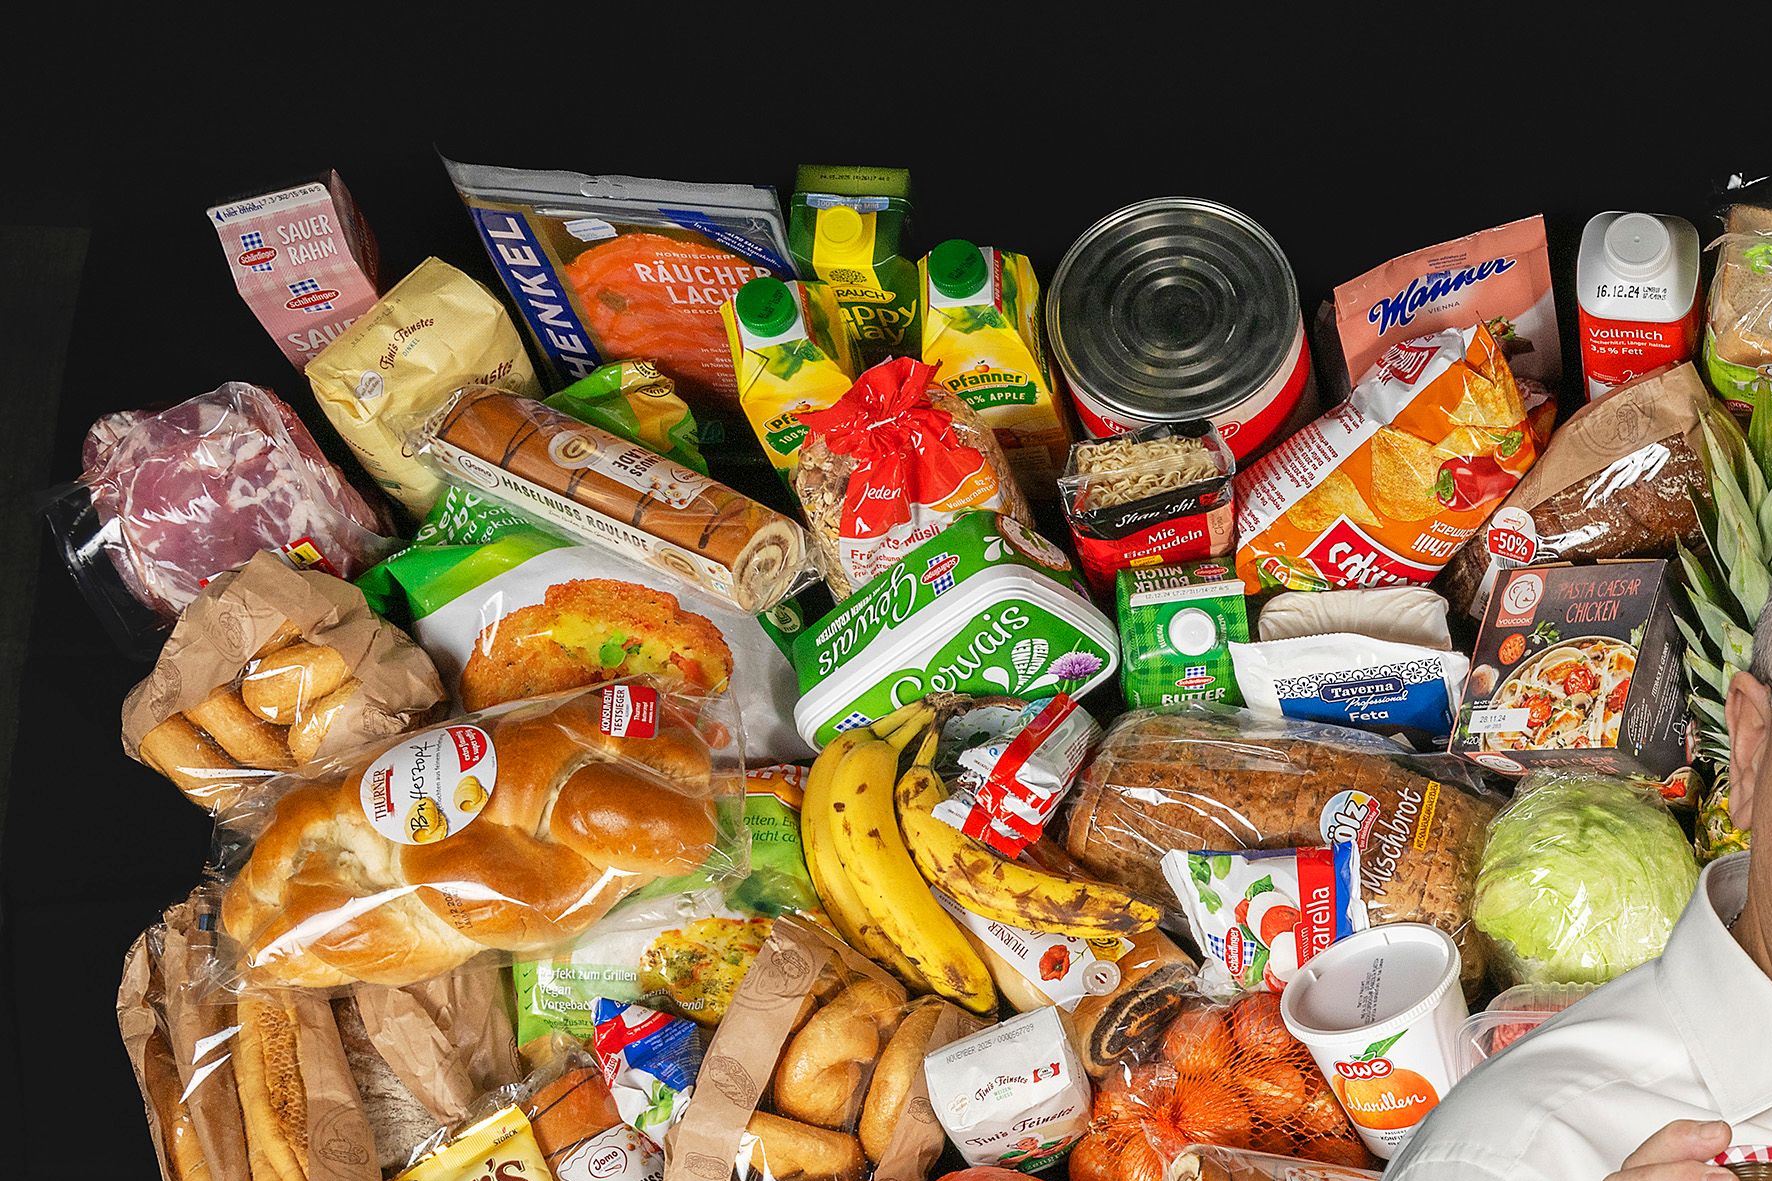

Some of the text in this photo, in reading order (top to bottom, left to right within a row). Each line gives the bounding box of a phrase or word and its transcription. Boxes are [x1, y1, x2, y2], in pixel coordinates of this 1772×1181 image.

[276, 214, 333, 245] SAUER
[241, 250, 275, 264] Schärdinger
[287, 237, 338, 266] RAHM
[289, 291, 336, 308] Schärdinger
[835, 288, 885, 301] RAUCH
[1368, 256, 1517, 336] Manner
[1596, 285, 1640, 299] 16.12.24
[1427, 301, 1460, 315] VIENNA
[1588, 327, 1663, 341] Vollmilch
[402, 337, 421, 357] DINKEL
[1621, 346, 1643, 356] Fett
[951, 373, 1024, 390] Pfanner
[990, 392, 1026, 402] APPLE
[946, 480, 996, 510] Vollkornanteil
[502, 476, 581, 522] HASELNUSS
[586, 516, 649, 552] ROULADE
[1124, 528, 1203, 559] Eiernudeln
[1148, 526, 1176, 544] Mie
[1493, 532, 1528, 556] -50%
[1559, 579, 1641, 599] PASTA CAESAR
[1565, 600, 1618, 623] CHICKEN
[1162, 687, 1225, 706] BUTTER
[1330, 681, 1394, 699] Taverna
[613, 689, 625, 732] TESTSIEGER
[1344, 690, 1408, 711] Professional
[600, 690, 613, 732] KONSUMENT
[1349, 710, 1389, 722] Feta
[375, 768, 386, 822] THURNER
[1361, 787, 1422, 896] Mischbrot
[987, 922, 1028, 960] THURNER
[578, 970, 600, 980] zum
[603, 969, 637, 982] Grillen
[946, 1045, 977, 1064] NOVEMBER
[978, 1040, 992, 1051] 2025
[1346, 1093, 1427, 1112] Marillen
[1012, 1105, 1075, 1133] Feinstes
[493, 1129, 518, 1146] STORCK
[593, 1149, 620, 1172] Jomo
